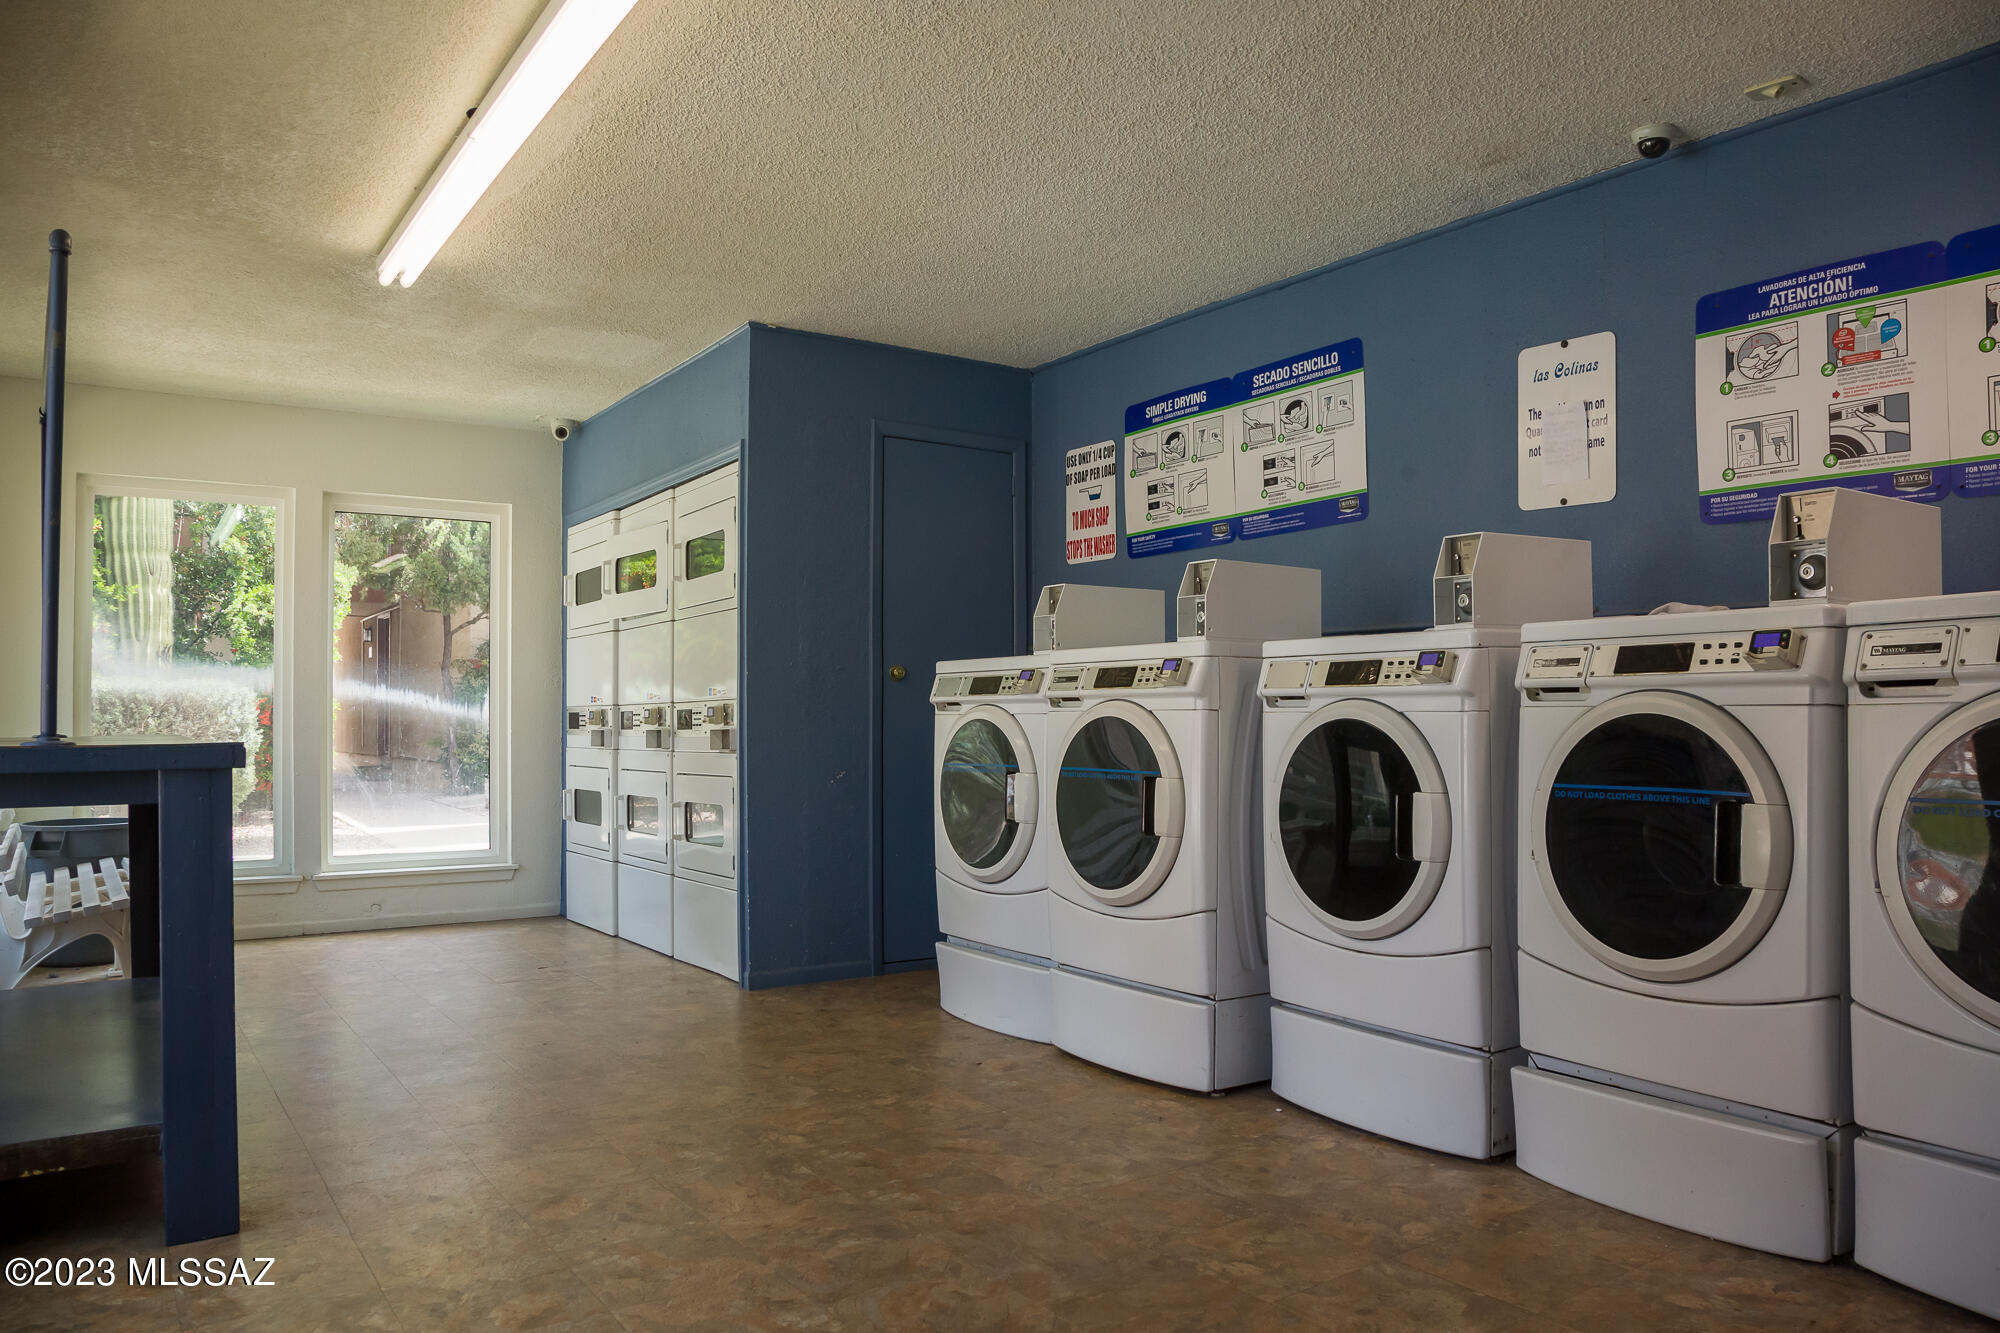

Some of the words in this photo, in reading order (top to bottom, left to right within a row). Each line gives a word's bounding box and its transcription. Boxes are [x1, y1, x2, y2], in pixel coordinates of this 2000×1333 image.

[1758, 278, 1796, 294] LAVADORAS
[1808, 272, 1825, 280] ALTA
[1827, 262, 1866, 276] EFICIENCIA
[1770, 276, 1852, 308] ATENCIÓN!
[1748, 312, 1760, 320] LEA
[1762, 308, 1778, 318] PARA
[1780, 302, 1806, 313] LOGRAR
[1808, 299, 1818, 307] UN
[1820, 292, 1847, 304] LAVADO
[1253, 368, 1290, 387] SECADO
[1292, 352, 1338, 376] SENCILLO
[1275, 378, 1296, 389] SENCILLAS
[1299, 371, 1323, 382] SECADORAS
[1534, 370, 1549, 382] las
[1554, 361, 1599, 378] Colinas
[1146, 399, 1172, 418] SIMPLE
[1174, 391, 1206, 409] DRYING
[1528, 408, 1542, 421] The
[1595, 399, 1604, 409] on
[1591, 414, 1608, 427] card
[1067, 453, 1077, 468] USE
[1078, 451, 1091, 465] ONLY
[1093, 448, 1102, 461] 1/4
[1103, 445, 1114, 459] CUP
[1529, 446, 1541, 457] not
[1587, 436, 1604, 448] ame
[1826, 456, 1834, 464] 4
[1066, 474, 1072, 486] OF
[1074, 470, 1088, 484] SOAP
[1090, 467, 1100, 480] PER
[1102, 463, 1115, 478] LOAD
[1898, 473, 1928, 482] MAYTAG
[1072, 511, 1079, 531] TO
[1080, 508, 1095, 529] MUCH
[1096, 506, 1109, 527] SOAP
[1067, 539, 1082, 560] STOPS
[1084, 537, 1092, 557] THE
[1094, 534, 1115, 556] WASHER
[1555, 790, 1566, 798] DO
[1568, 791, 1583, 799] NOT
[1607, 792, 1641, 800] CLOTHES
